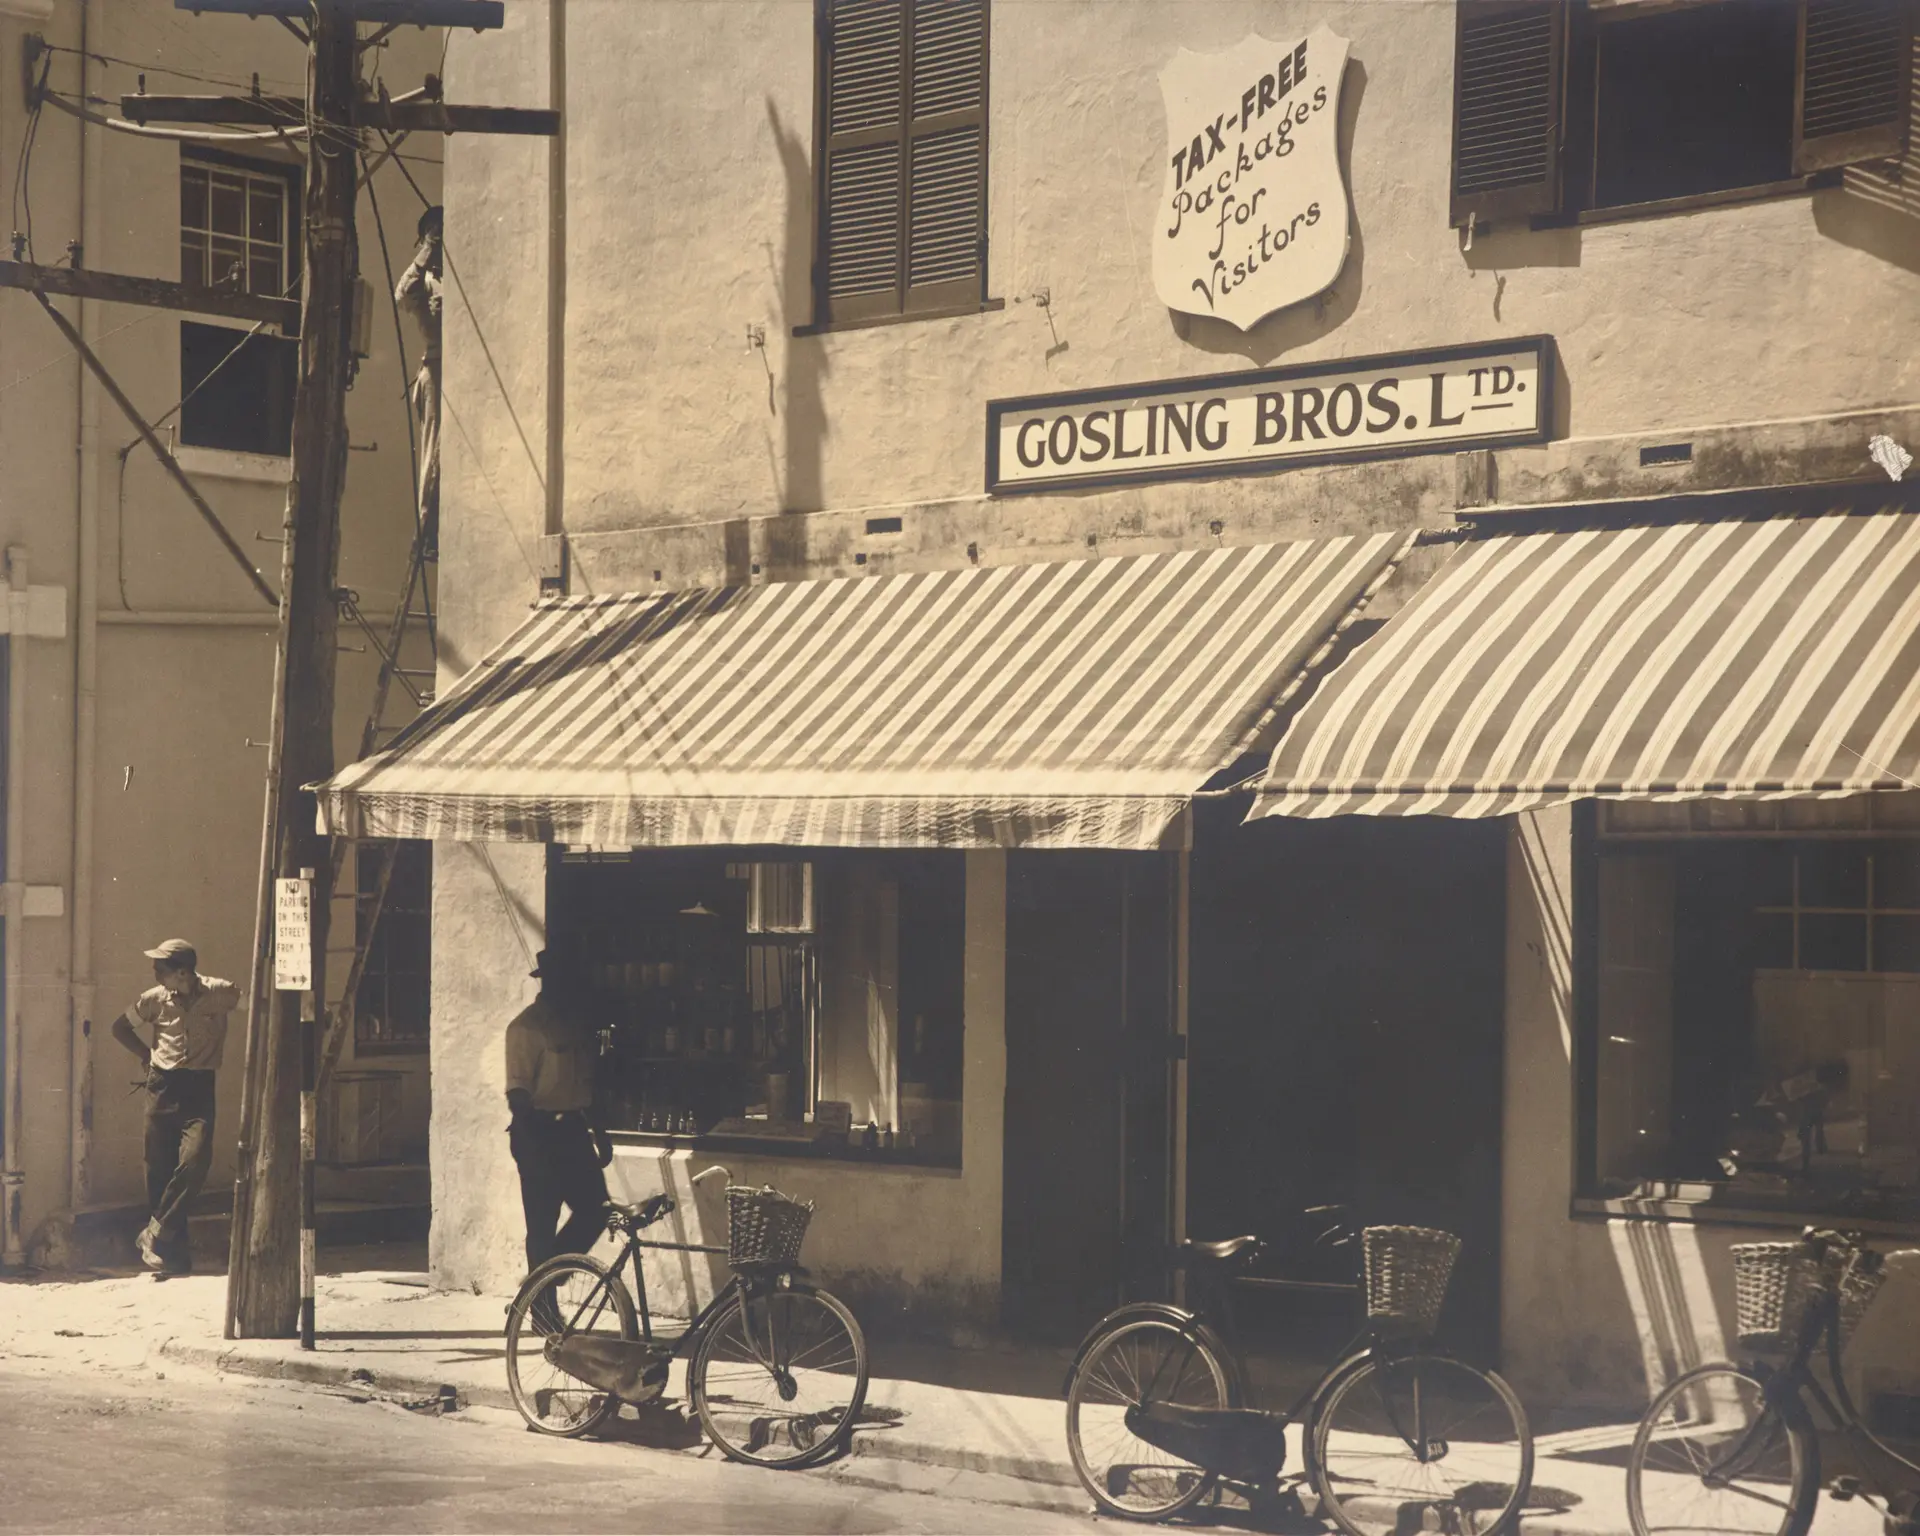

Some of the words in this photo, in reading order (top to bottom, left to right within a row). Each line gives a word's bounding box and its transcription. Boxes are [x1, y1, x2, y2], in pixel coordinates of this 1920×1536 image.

[1171, 37, 1308, 192] TAX-FREE
[1208, 187, 1267, 261] for
[1191, 201, 1321, 311] Visitors
[1016, 396, 1231, 469] GOSLING
[1253, 377, 1418, 447] BROS.
[285, 880, 300, 895] NO
[279, 895, 308, 909] PARKING
[278, 911, 287, 923] ON
[292, 911, 308, 923] THIS
[279, 926, 305, 938] STREET
[277, 942, 295, 954] FROM
[278, 959, 287, 969] TO
